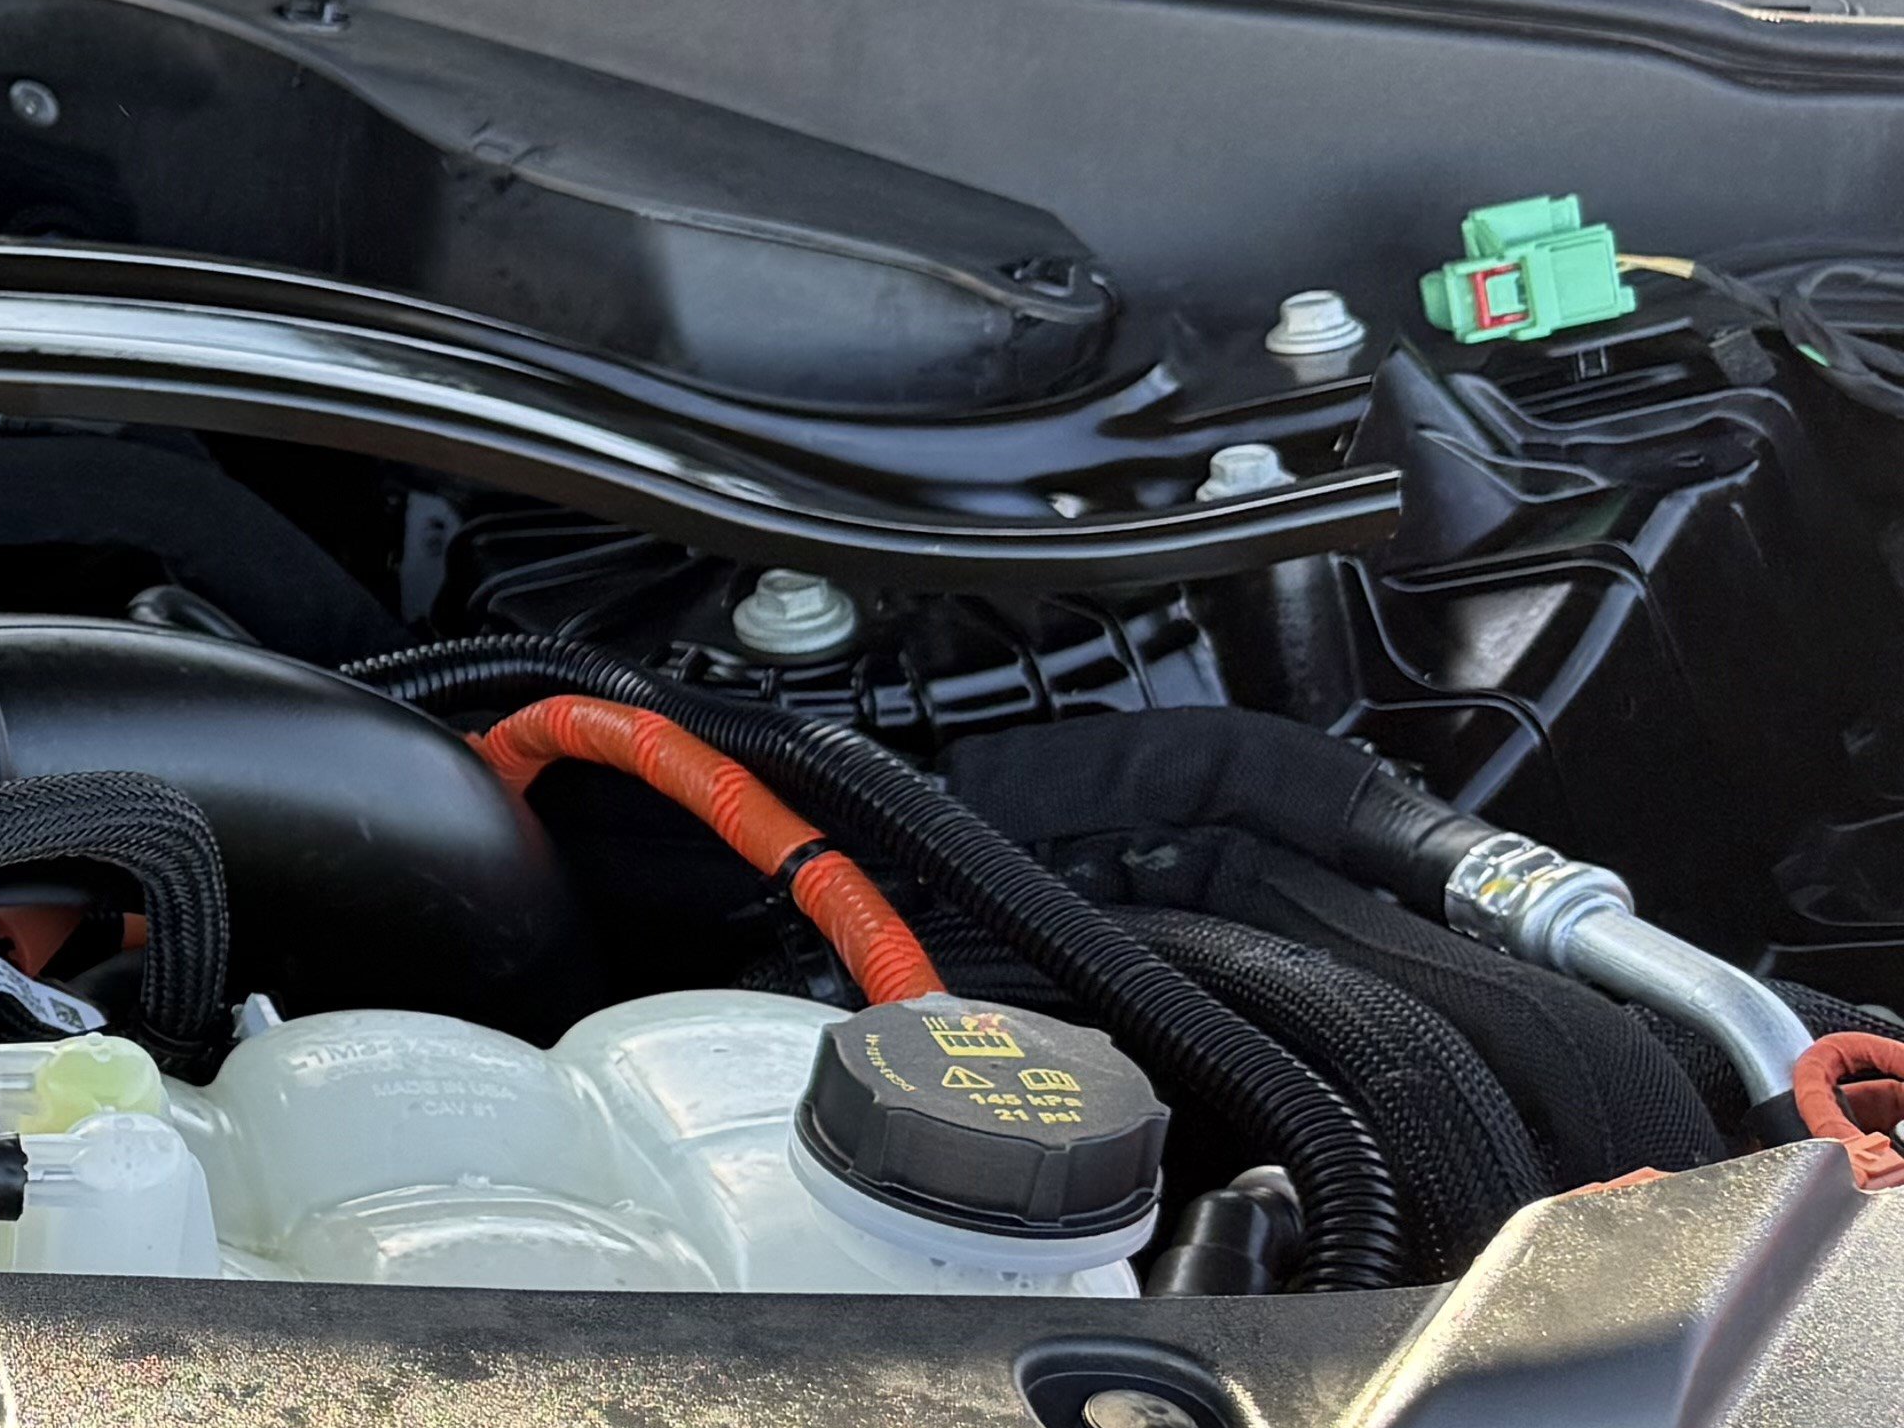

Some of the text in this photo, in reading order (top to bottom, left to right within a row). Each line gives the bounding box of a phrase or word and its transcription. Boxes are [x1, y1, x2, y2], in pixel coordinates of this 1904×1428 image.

[969, 1093, 1083, 1107] 145 kPa
[994, 1108, 1082, 1124] 21 psi
